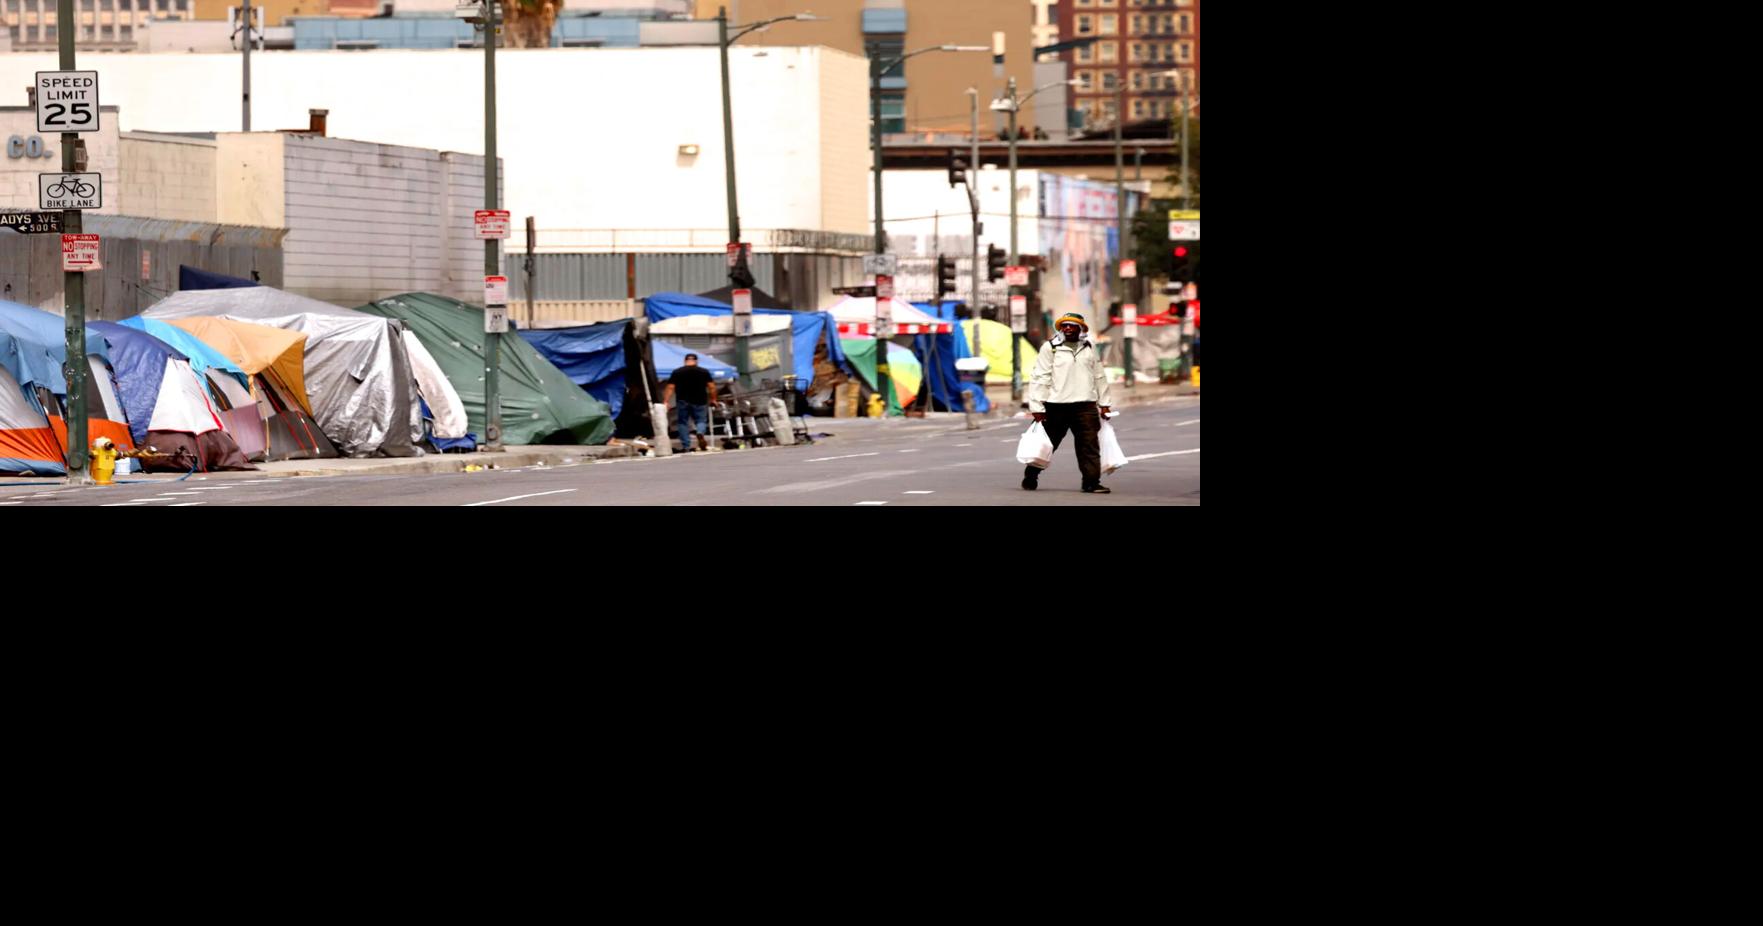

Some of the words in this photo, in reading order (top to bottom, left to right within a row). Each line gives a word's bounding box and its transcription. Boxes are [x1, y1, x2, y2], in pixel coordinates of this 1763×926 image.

[41, 77, 93, 88] SPEED
[47, 90, 87, 100] LIMIT
[44, 103, 92, 125] 25
[7, 135, 53, 159] CO.
[0, 214, 31, 224] ADYS
[30, 223, 48, 232] 500
[63, 241, 74, 251] NO
[74, 242, 98, 250] STOPPING
